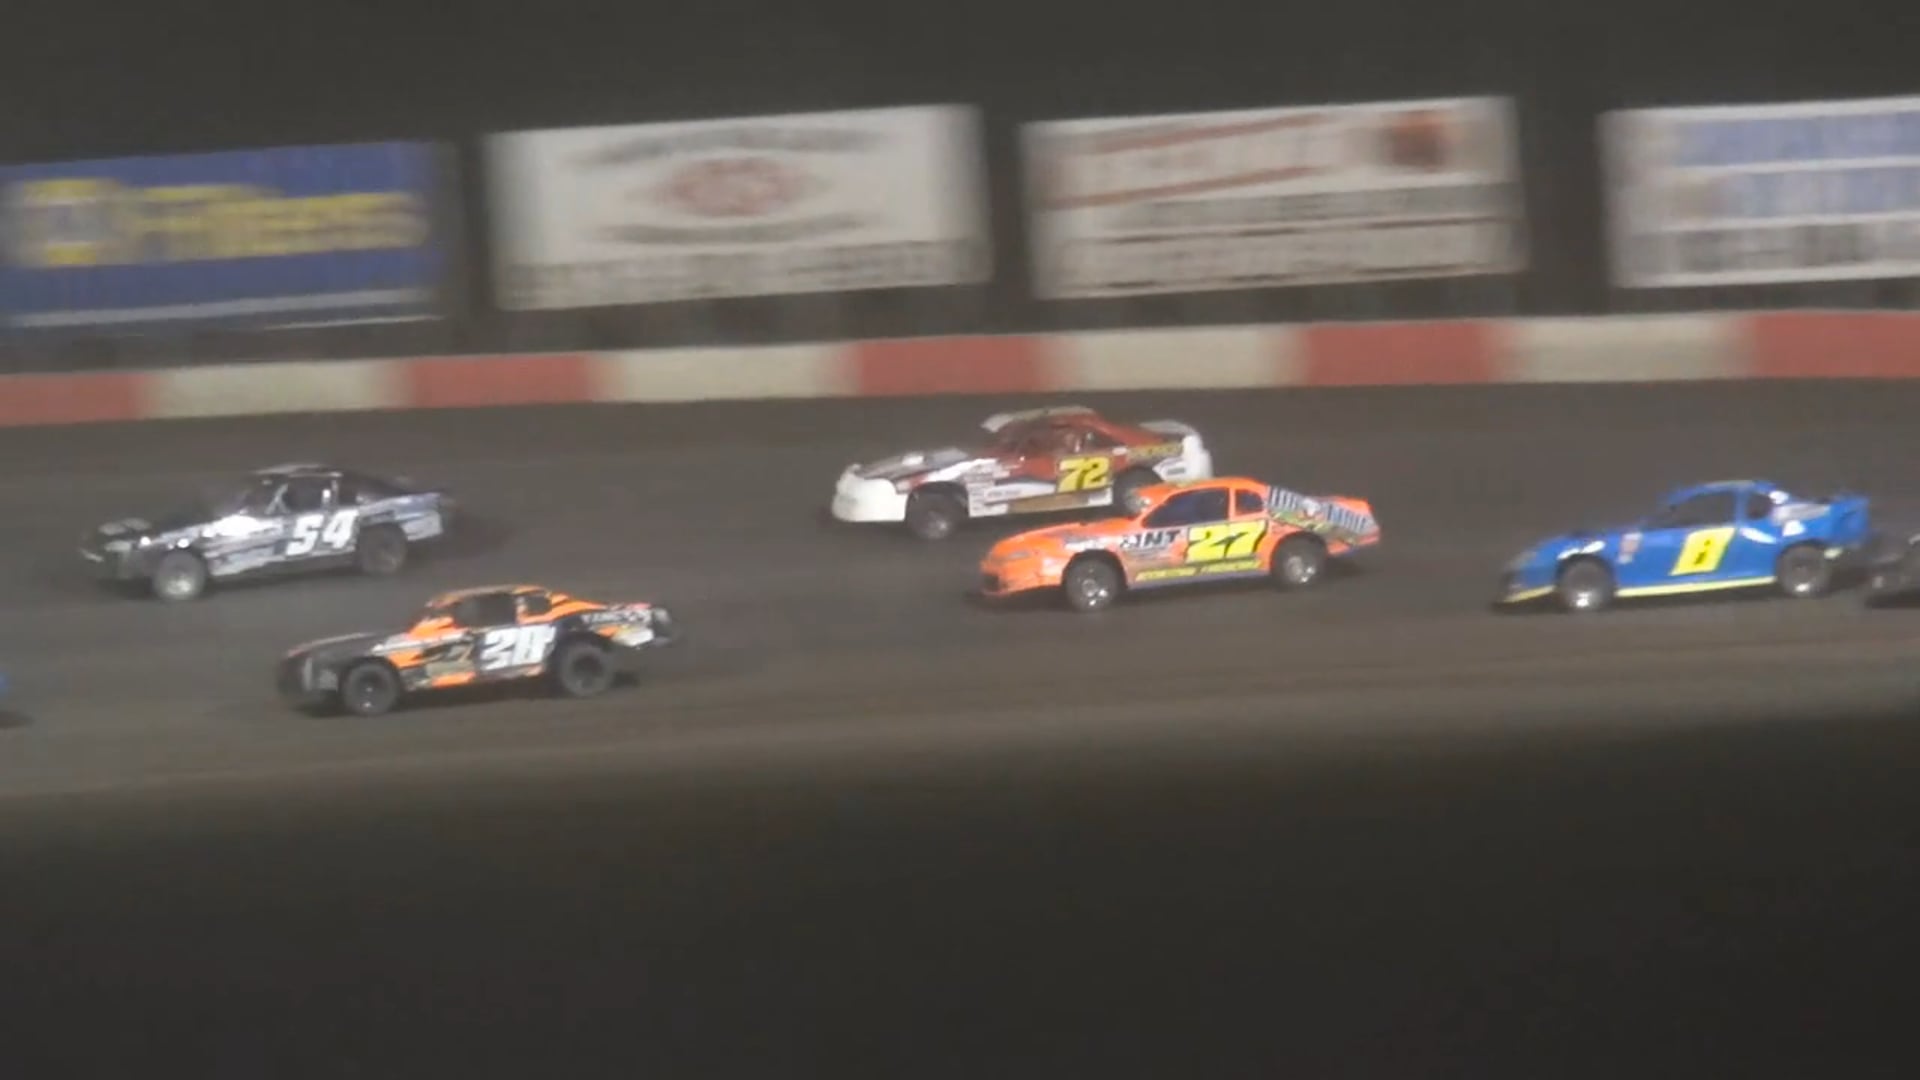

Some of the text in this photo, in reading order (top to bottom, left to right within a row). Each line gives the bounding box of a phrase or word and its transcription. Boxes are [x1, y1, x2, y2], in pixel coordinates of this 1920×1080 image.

[1057, 456, 1110, 492] 72
[286, 509, 359, 555] 54
[1185, 520, 1268, 564] 27
[1668, 528, 1735, 576] 8
